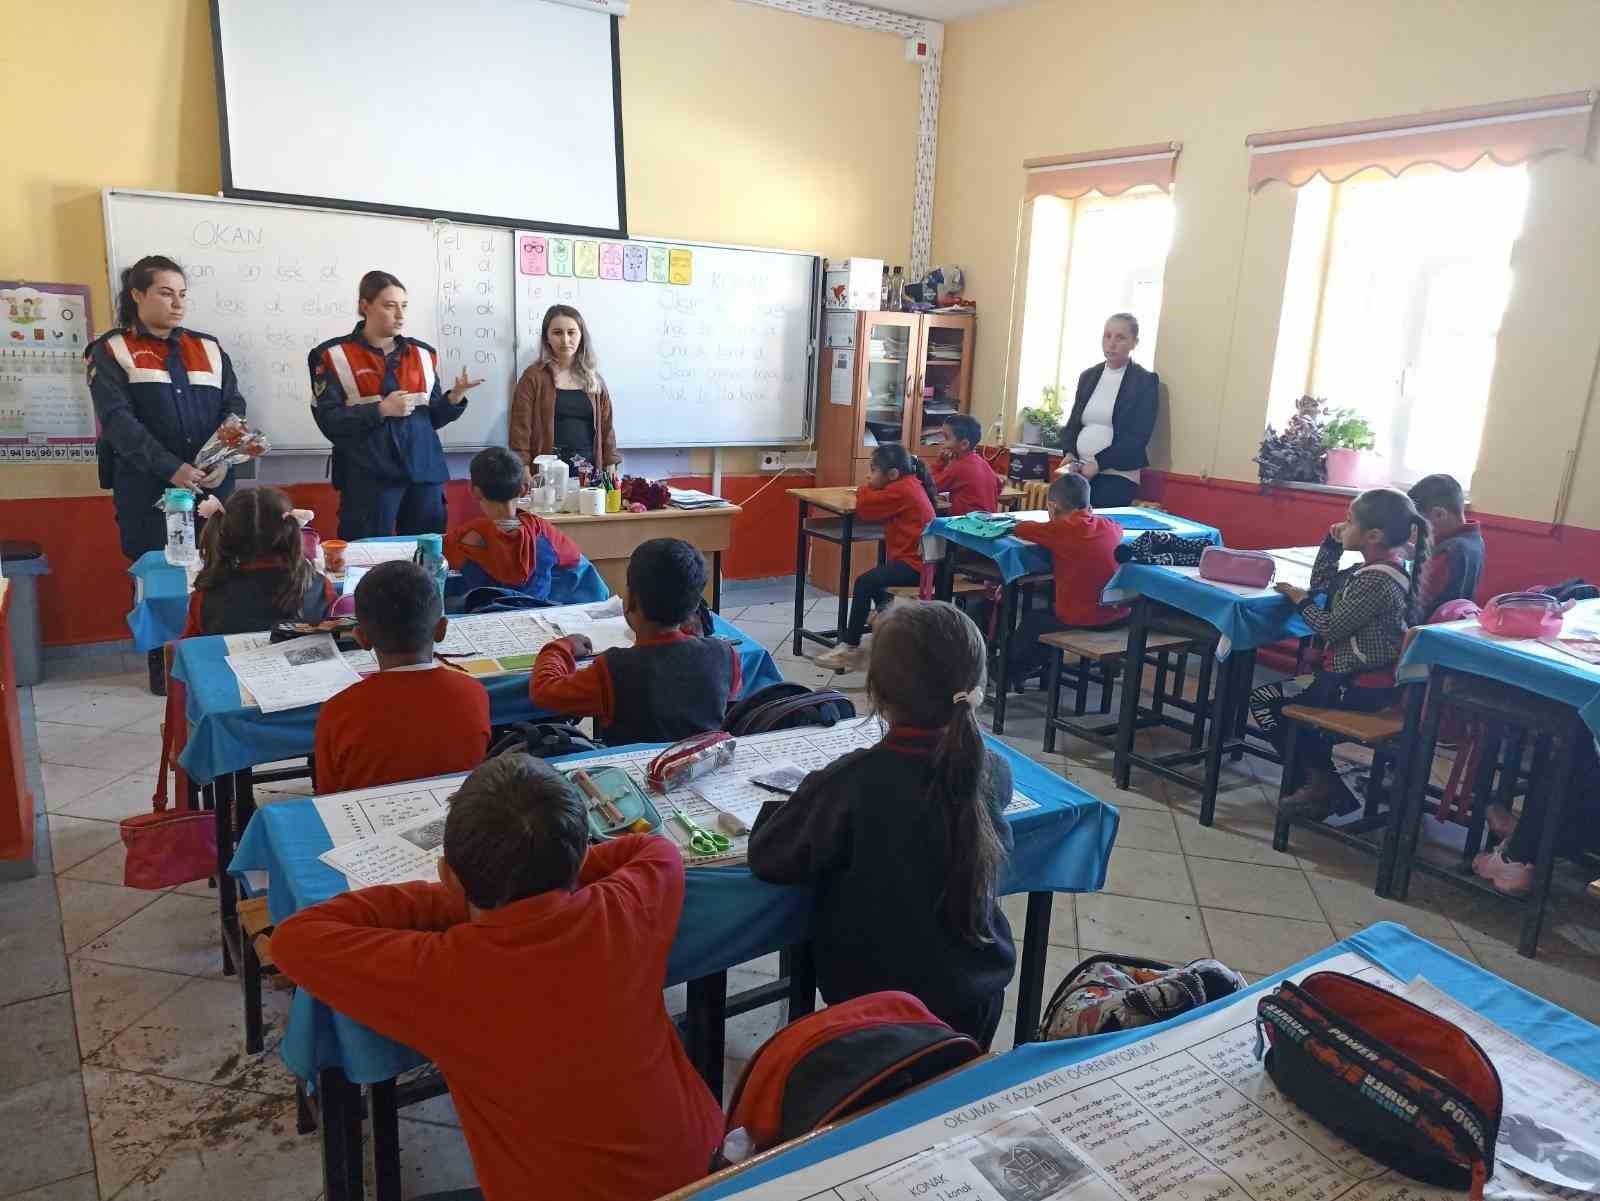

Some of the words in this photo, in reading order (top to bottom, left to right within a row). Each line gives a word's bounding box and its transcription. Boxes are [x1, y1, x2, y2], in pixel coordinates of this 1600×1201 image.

[192, 220, 264, 248] OKAN
[440, 320, 463, 338] en
[943, 1101, 1001, 1130] OKUMA
[1000, 1072, 1064, 1109] YAZMAYI
[908, 1172, 950, 1198] KONAK
